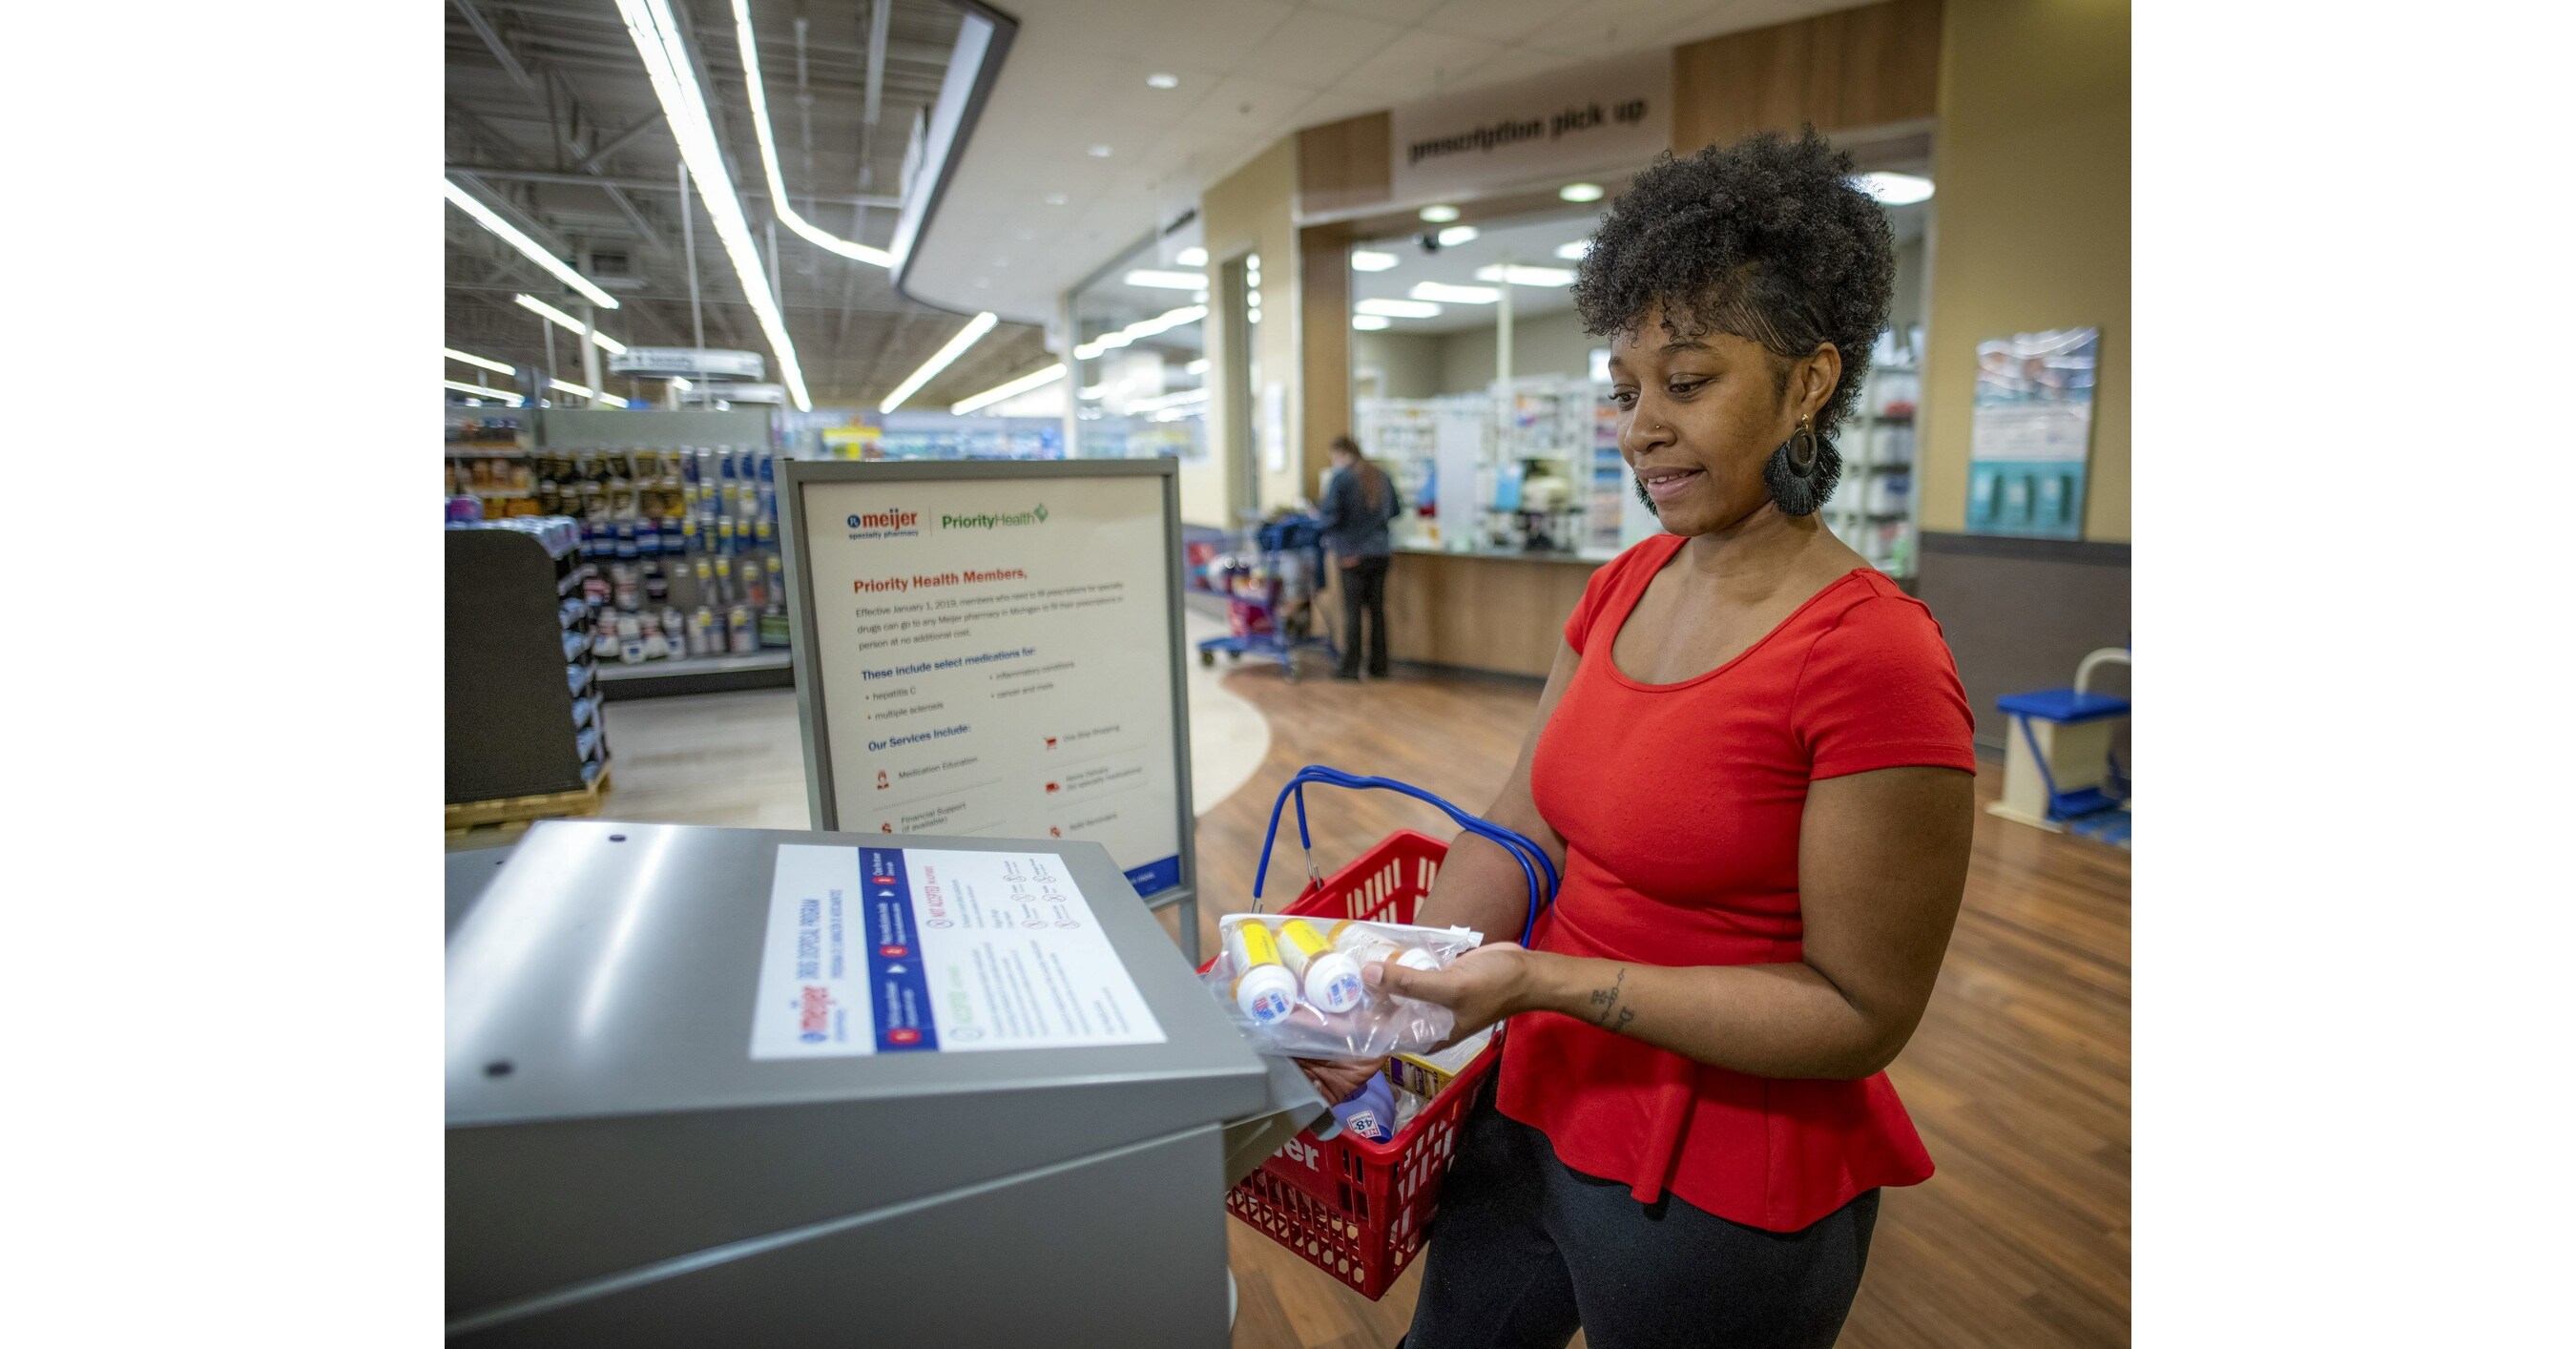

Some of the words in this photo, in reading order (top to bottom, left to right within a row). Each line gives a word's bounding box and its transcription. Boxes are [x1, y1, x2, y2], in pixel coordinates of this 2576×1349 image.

[1408, 117, 1544, 166] prescription
[1548, 102, 1605, 138] pick
[1613, 97, 1648, 127] up
[862, 508, 918, 531] meijer
[942, 511, 1035, 529] PriorityHealth
[848, 530, 882, 540] specialty
[883, 529, 919, 539] pharmacy
[854, 578, 908, 594] Priority
[913, 571, 960, 589] Health
[963, 568, 1028, 584] Members,
[856, 608, 891, 618] Effective
[893, 604, 924, 614] January
[857, 624, 882, 635] drugs
[883, 622, 899, 631] can
[901, 621, 911, 631] go
[912, 619, 921, 628] to
[922, 618, 937, 628] any
[964, 611, 1000, 623] pharmacy
[859, 640, 888, 651] person
[890, 638, 899, 648] at
[900, 636, 911, 646] no
[913, 631, 952, 644] additional
[862, 670, 893, 682] These
[895, 663, 932, 677] include
[934, 657, 963, 671] select
[965, 651, 1021, 667] medications
[1022, 647, 1036, 657] for:
[873, 687, 909, 702] hepatitis
[910, 685, 917, 696] C
[875, 708, 908, 721] multiple
[909, 701, 944, 716] sclerosis
[868, 740, 886, 753] Our
[889, 733, 932, 748] Services
[933, 724, 971, 739] Include:
[898, 764, 941, 779] Medication
[942, 757, 979, 770] Education
[901, 810, 935, 824] Financial
[937, 801, 966, 815] Support
[800, 899, 821, 926] PROGRAM
